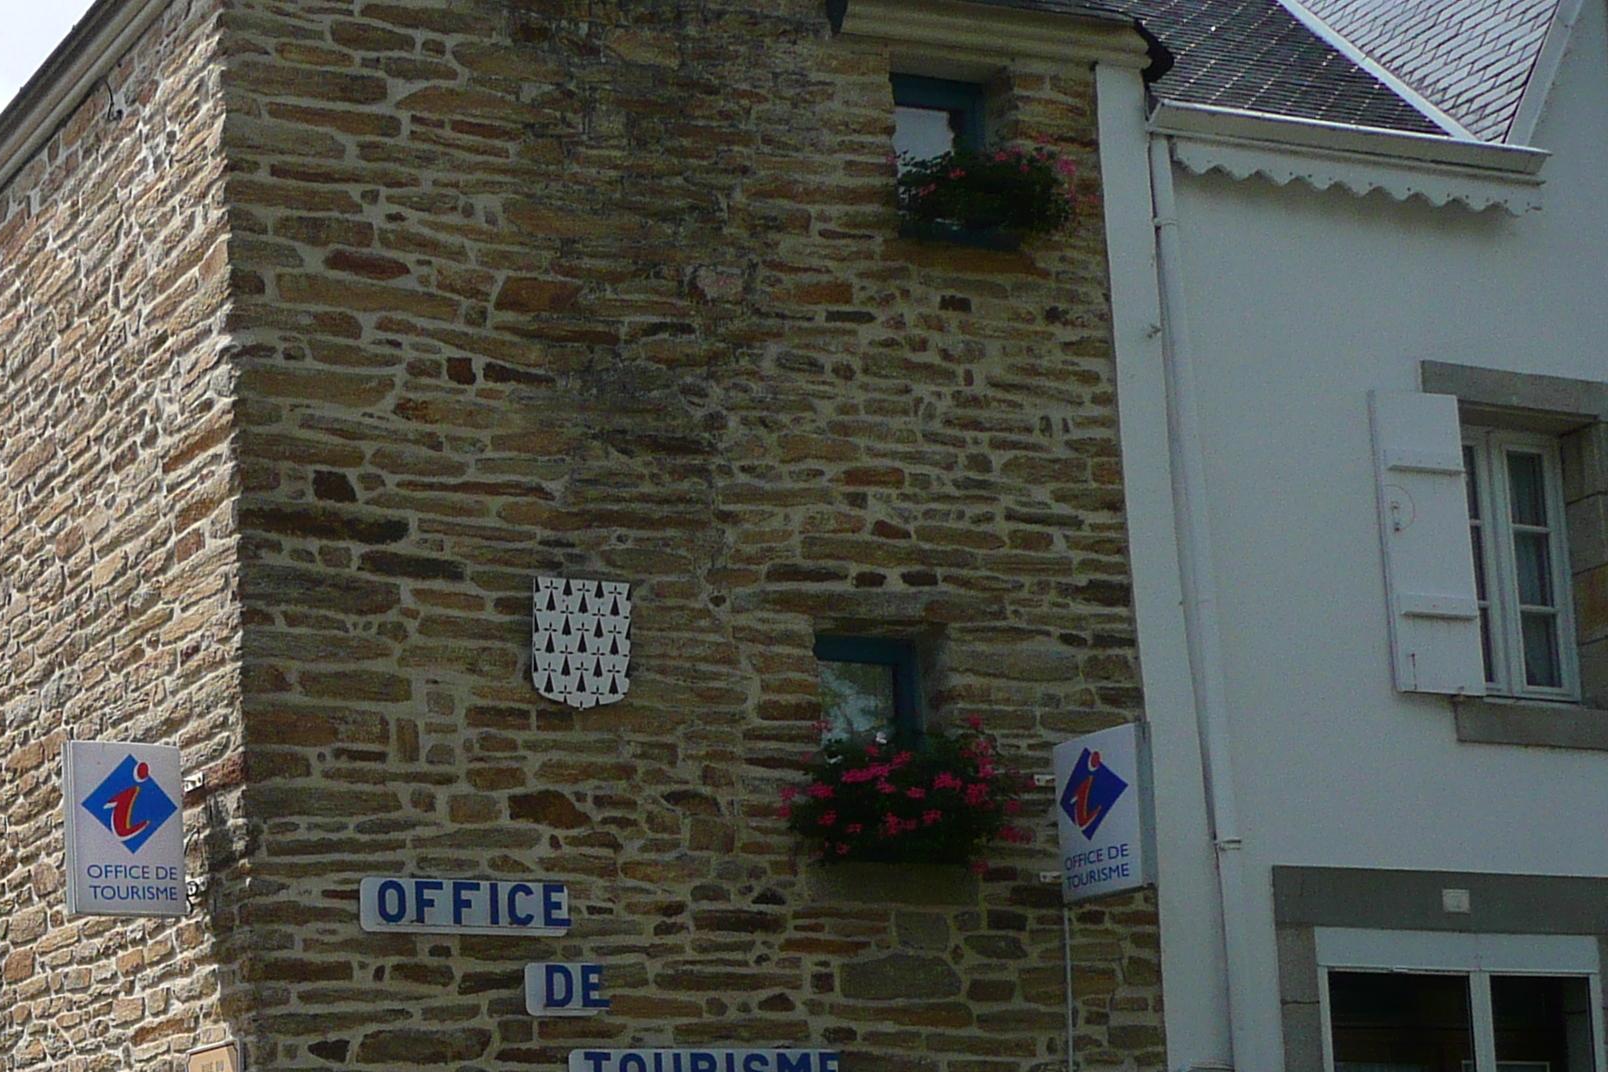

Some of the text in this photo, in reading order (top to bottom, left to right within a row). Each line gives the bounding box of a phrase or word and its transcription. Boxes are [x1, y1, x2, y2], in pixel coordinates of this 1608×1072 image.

[1065, 843, 1129, 872] OFFICE DE
[86, 863, 178, 881] OFFICE DE
[1066, 863, 1130, 889] TOURISME
[88, 885, 179, 902] TOURISME
[375, 879, 573, 927] OFFICE
[544, 964, 610, 1010] DE
